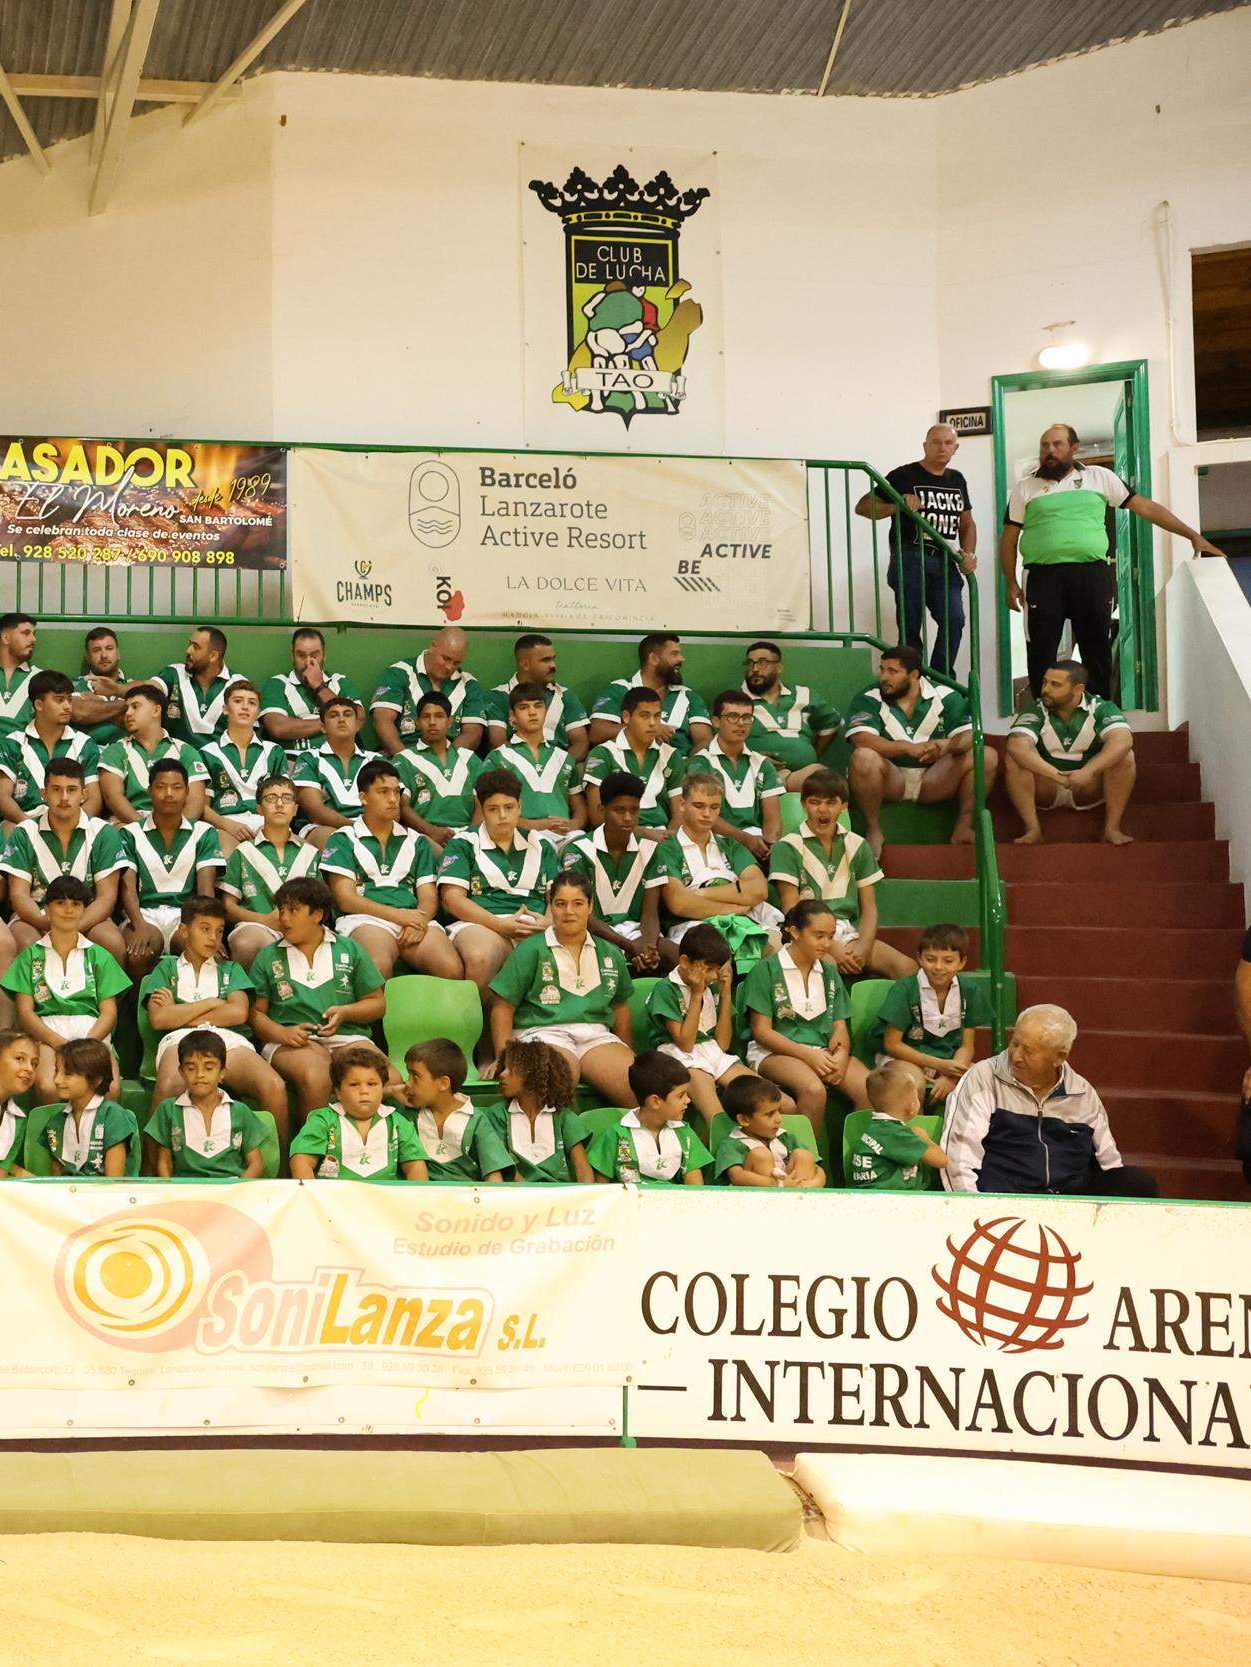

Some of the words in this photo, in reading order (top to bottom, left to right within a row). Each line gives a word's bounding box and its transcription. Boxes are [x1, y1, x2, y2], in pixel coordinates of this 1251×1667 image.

[596, 245, 642, 263] CLUB
[576, 262, 597, 279] DE
[606, 263, 666, 282] LUCHA
[595, 371, 654, 389] TAO
[949, 415, 984, 431] OFICINA
[479, 466, 577, 489] Barceló
[3, 481, 61, 521] El
[74, 466, 180, 527] Moreno
[192, 486, 222, 510] desde
[229, 473, 271, 501] 1989
[480, 495, 608, 519] Lanzarote
[7, 524, 23, 535] Se
[25, 524, 81, 537] celebran
[84, 526, 114, 537] toda
[117, 528, 149, 539] clase
[152, 528, 169, 539] de
[171, 531, 220, 541] eventos
[179, 515, 203, 525] SAN
[205, 515, 273, 527] BARTOLOMÉ
[921, 512, 961, 535] ONE
[480, 525, 559, 547] Active
[566, 526, 647, 550] Resort
[24, 545, 52, 559] 928
[58, 546, 86, 560] 520
[91, 547, 122, 561] 287
[137, 548, 167, 563] 690
[172, 550, 201, 564] 908
[205, 551, 235, 565] 898
[700, 543, 772, 559] ACTIVE
[677, 560, 702, 575] BE
[336, 580, 392, 606] CHAMPS
[507, 576, 529, 589] LA
[537, 576, 599, 592] DOLCE
[605, 578, 647, 592] VITA
[414, 1211, 514, 1234] Sonido
[521, 1213, 539, 1234] y
[545, 1206, 596, 1228] Luz
[393, 1237, 471, 1256] Estudio
[478, 1240, 502, 1256] de
[510, 1233, 616, 1255] Grabación
[202, 1272, 485, 1351] SoniLanza
[641, 1270, 918, 1342] COLEGIO
[1103, 1287, 1251, 1359] ARE
[707, 1357, 1251, 1449] INTERNACIONA
